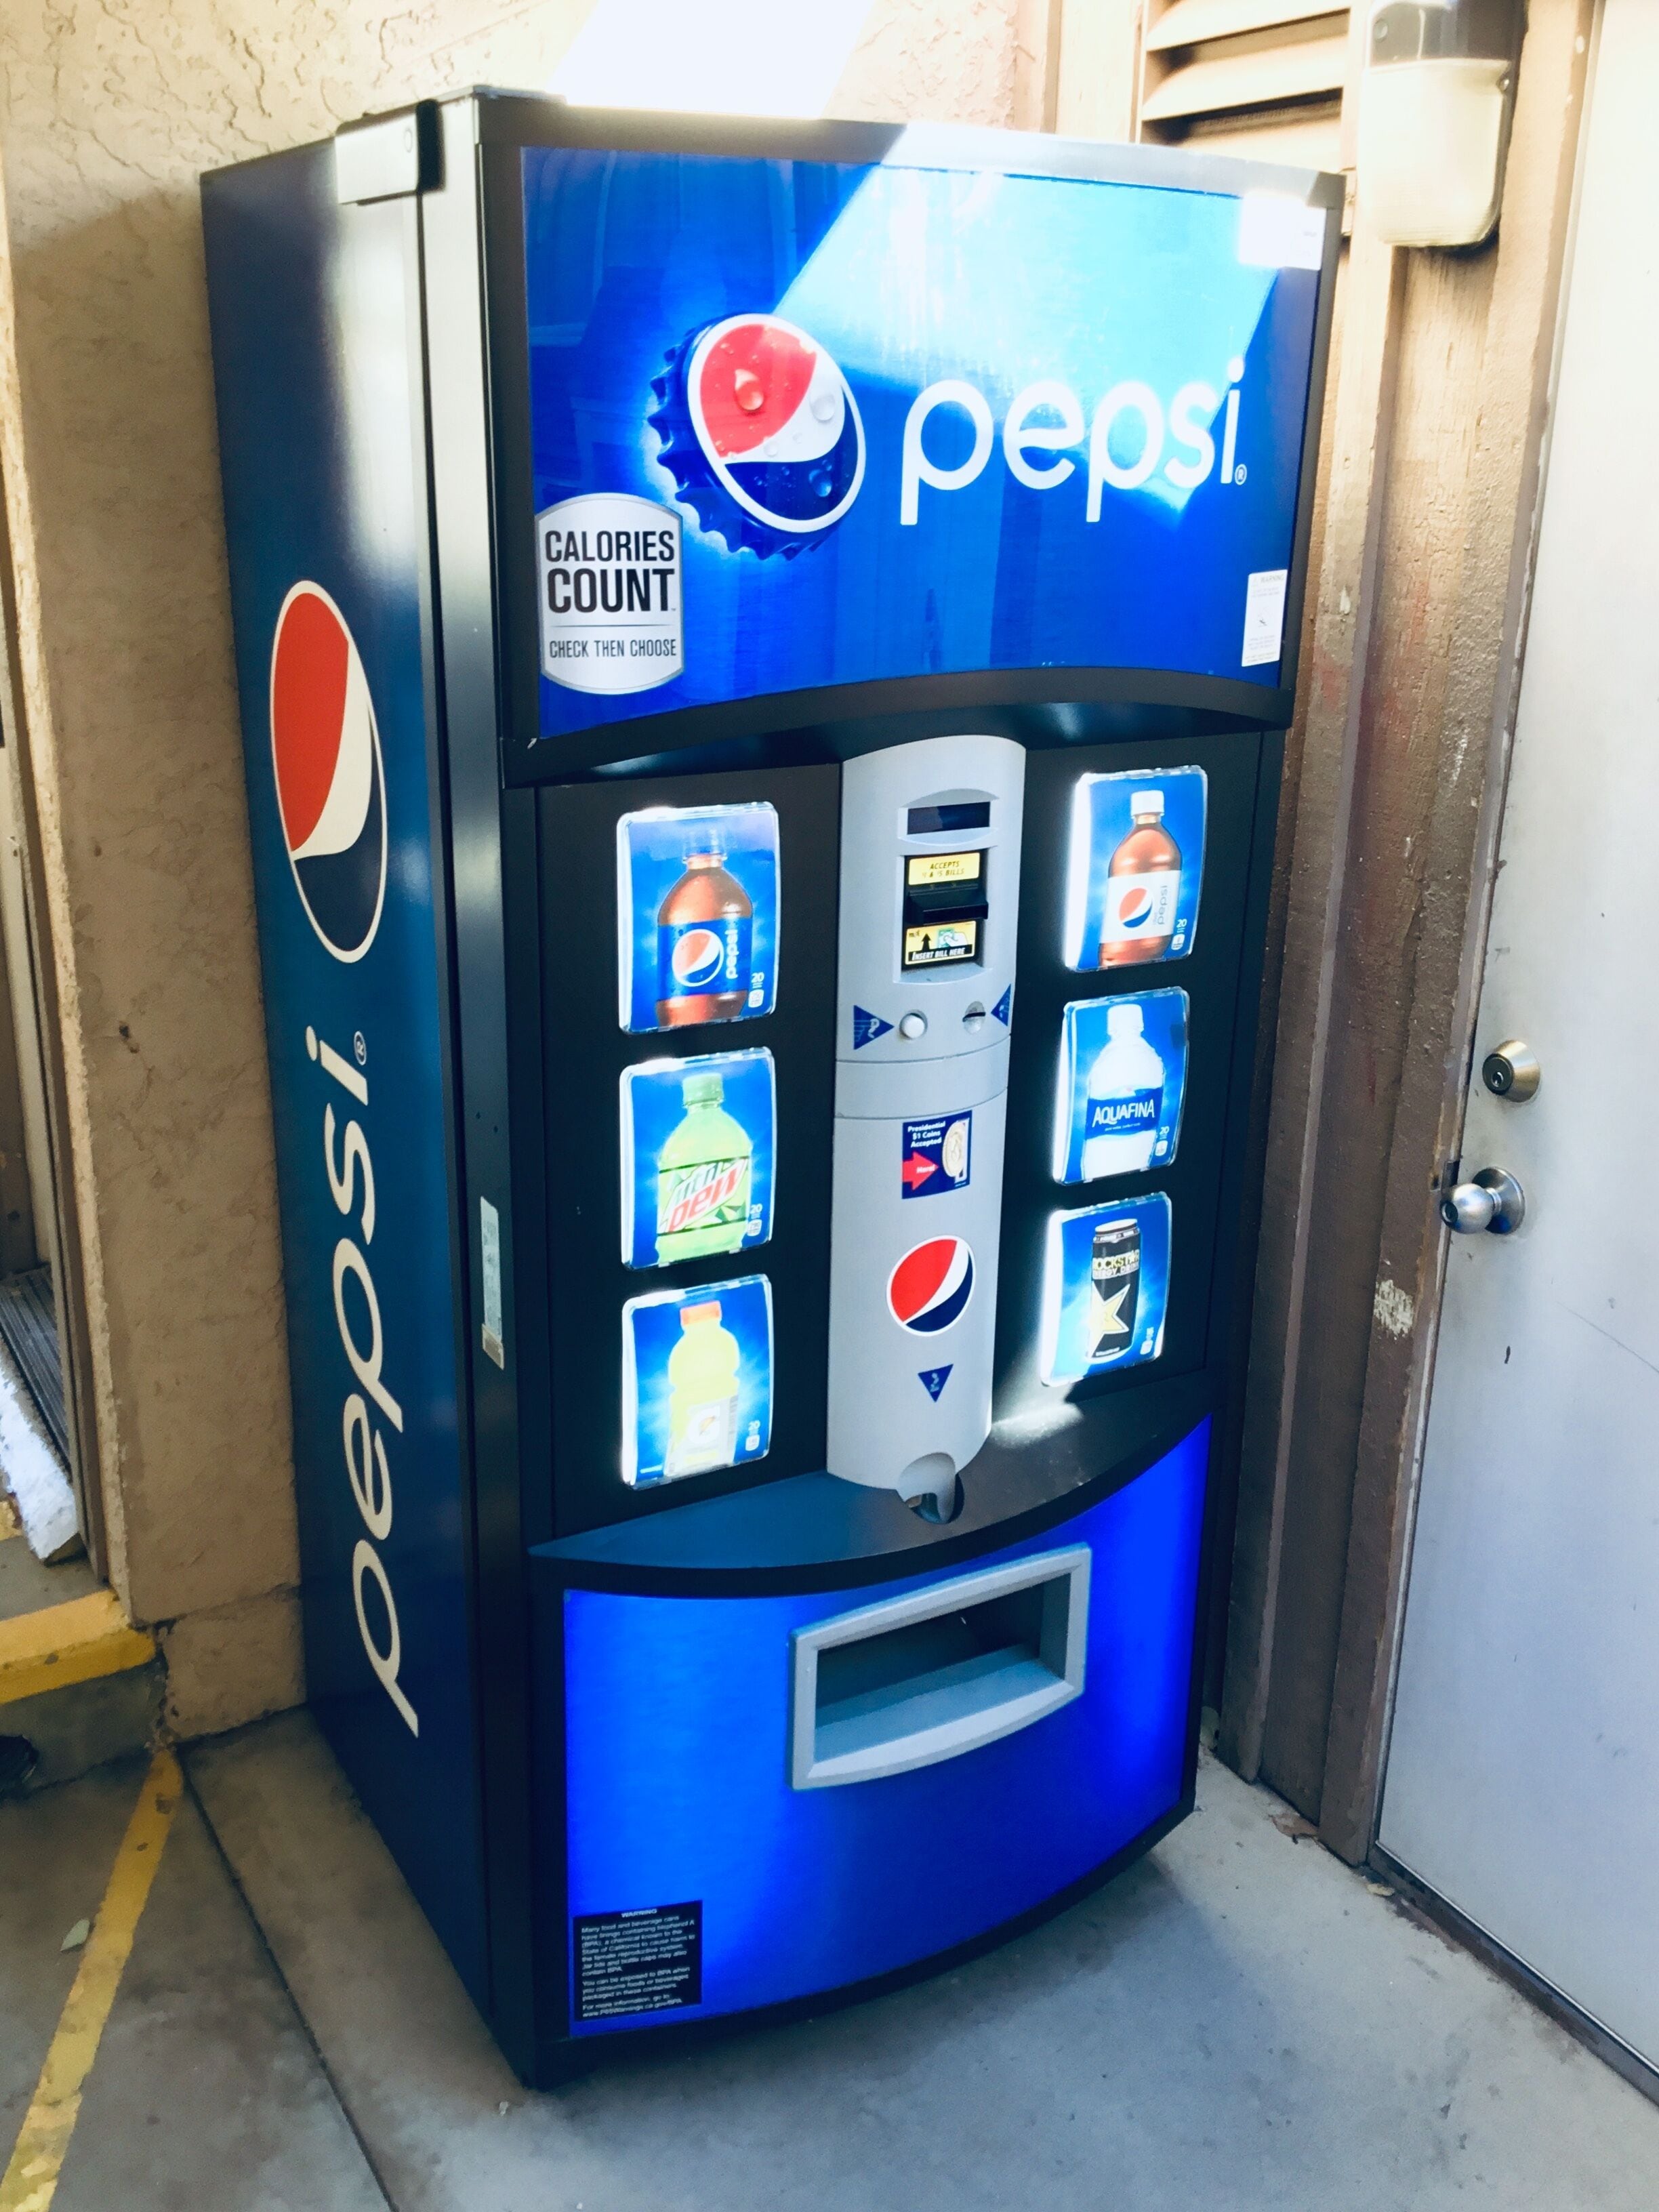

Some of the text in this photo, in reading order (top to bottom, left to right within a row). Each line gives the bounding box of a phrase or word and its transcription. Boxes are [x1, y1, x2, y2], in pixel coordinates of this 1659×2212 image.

[900, 356, 1244, 525] pepsi
[545, 531, 675, 562] CALORIES
[547, 568, 676, 613] COUNT
[549, 638, 677, 658] CHECK THEN CHOOSE
[930, 861, 960, 869] ACCEPTS
[945, 868, 965, 876] BILLS
[1092, 1099, 1155, 1128] AQUAFINA
[306, 1025, 419, 1739] pepsi
